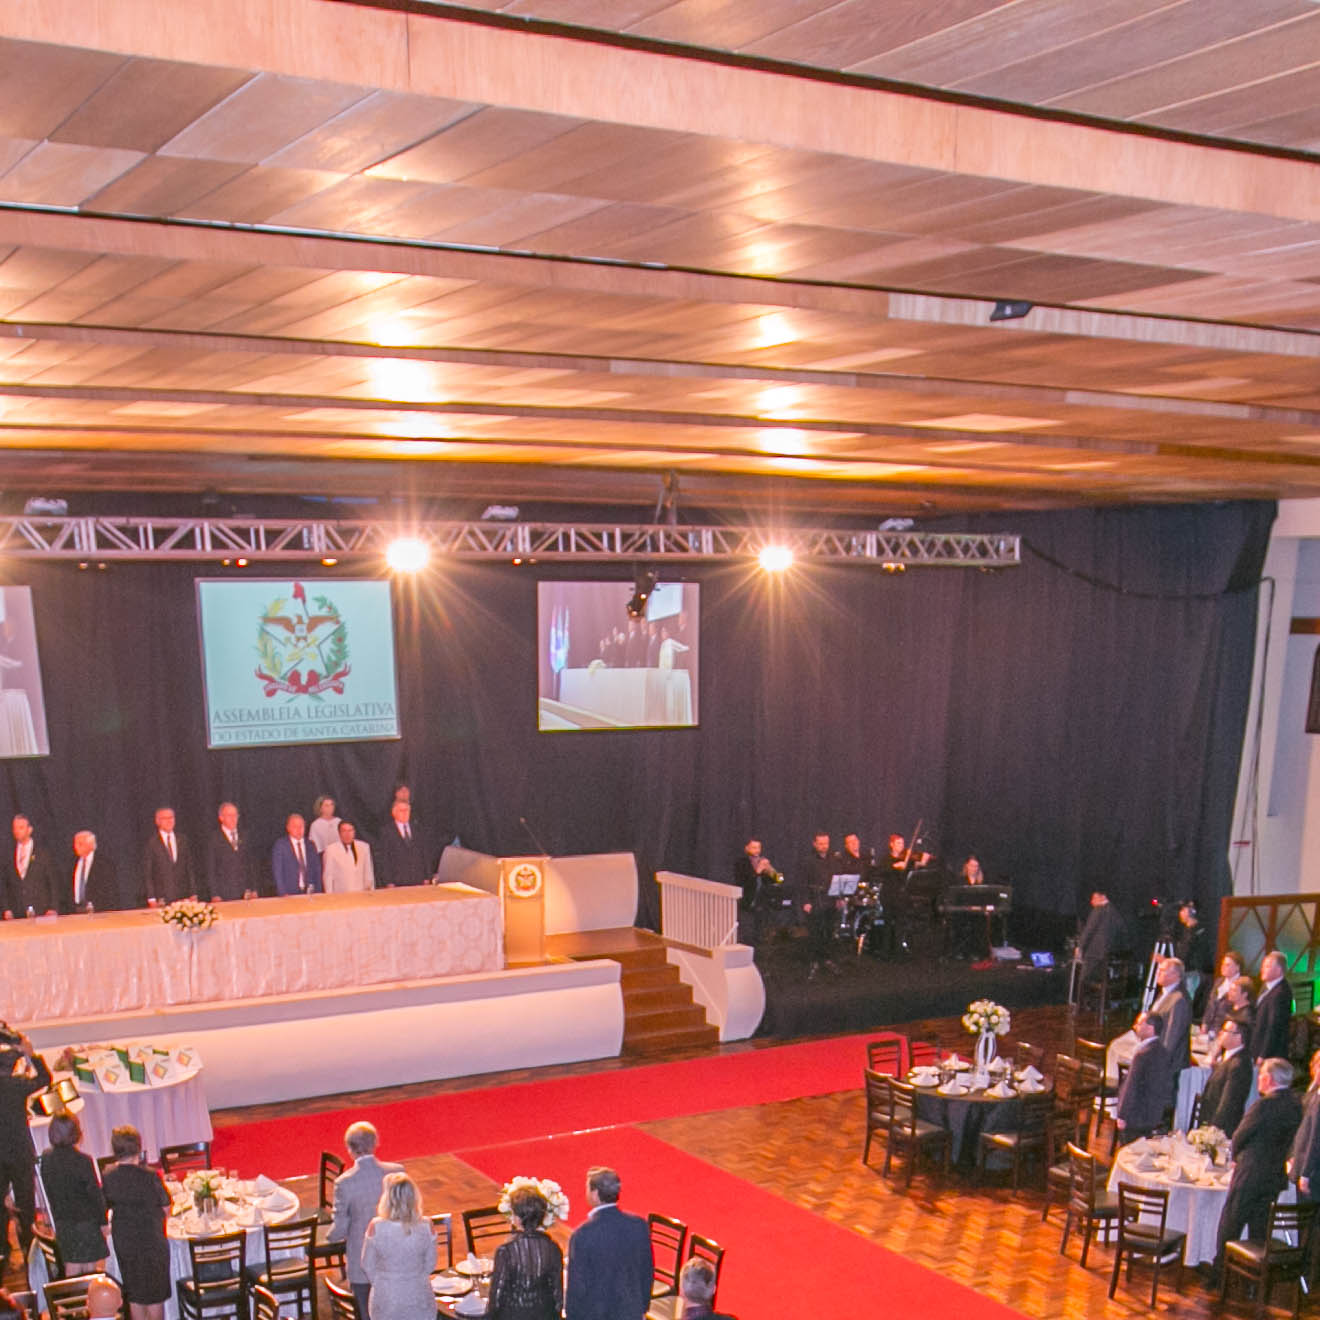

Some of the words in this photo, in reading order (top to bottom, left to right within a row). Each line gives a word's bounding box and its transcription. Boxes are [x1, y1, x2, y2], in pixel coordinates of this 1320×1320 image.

[212, 706, 300, 723] ASSEMBLEIA
[307, 702, 395, 720] LEGISLATIVA
[235, 728, 281, 741] ESTADO
[283, 727, 299, 739] DE
[301, 725, 339, 738] SANTA
